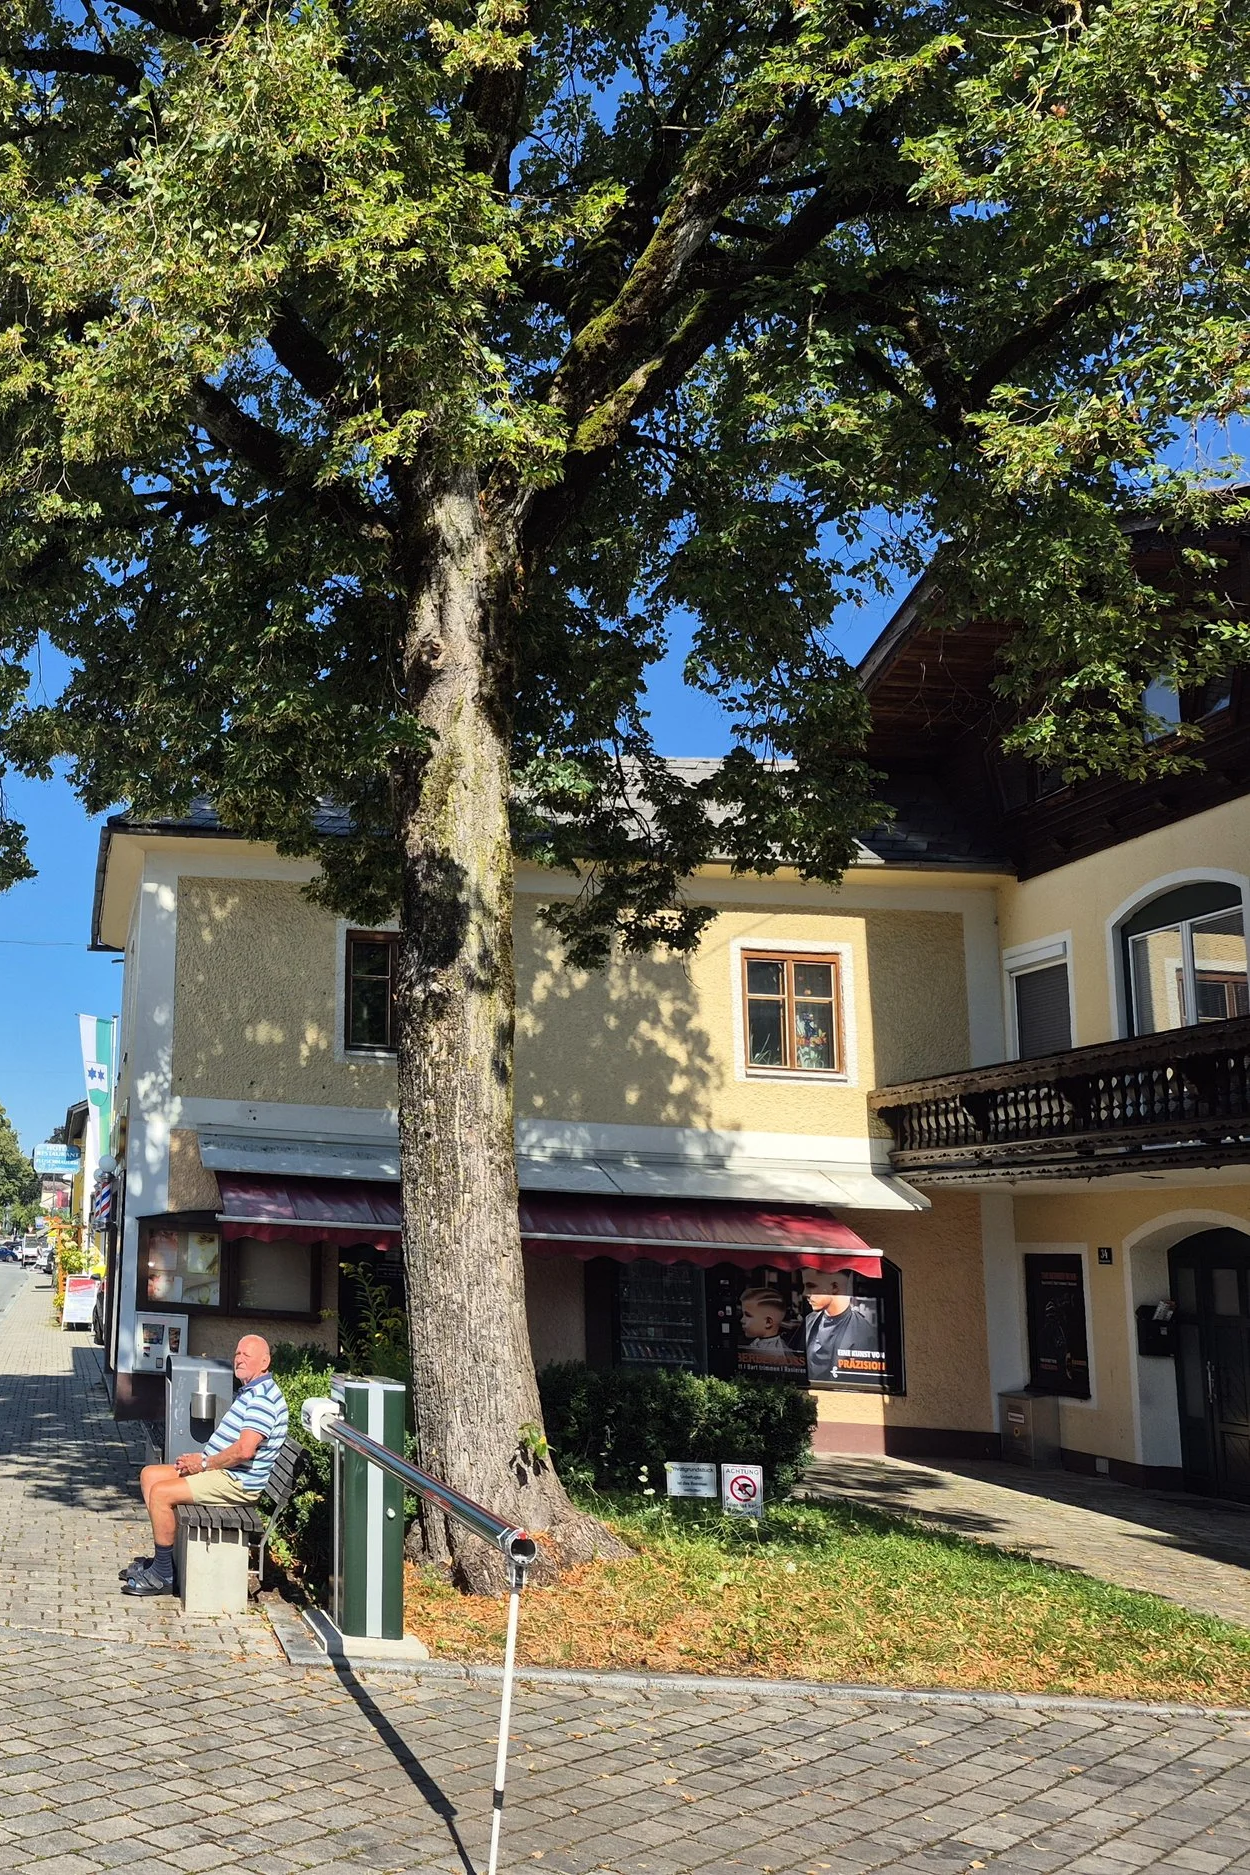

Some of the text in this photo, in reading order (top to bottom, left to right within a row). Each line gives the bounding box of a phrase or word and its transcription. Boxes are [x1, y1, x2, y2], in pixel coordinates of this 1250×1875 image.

[837, 1349, 851, 1357] EINE
[851, 1349, 871, 1358] KUNST
[837, 1358, 886, 1371] PRÄZISION
